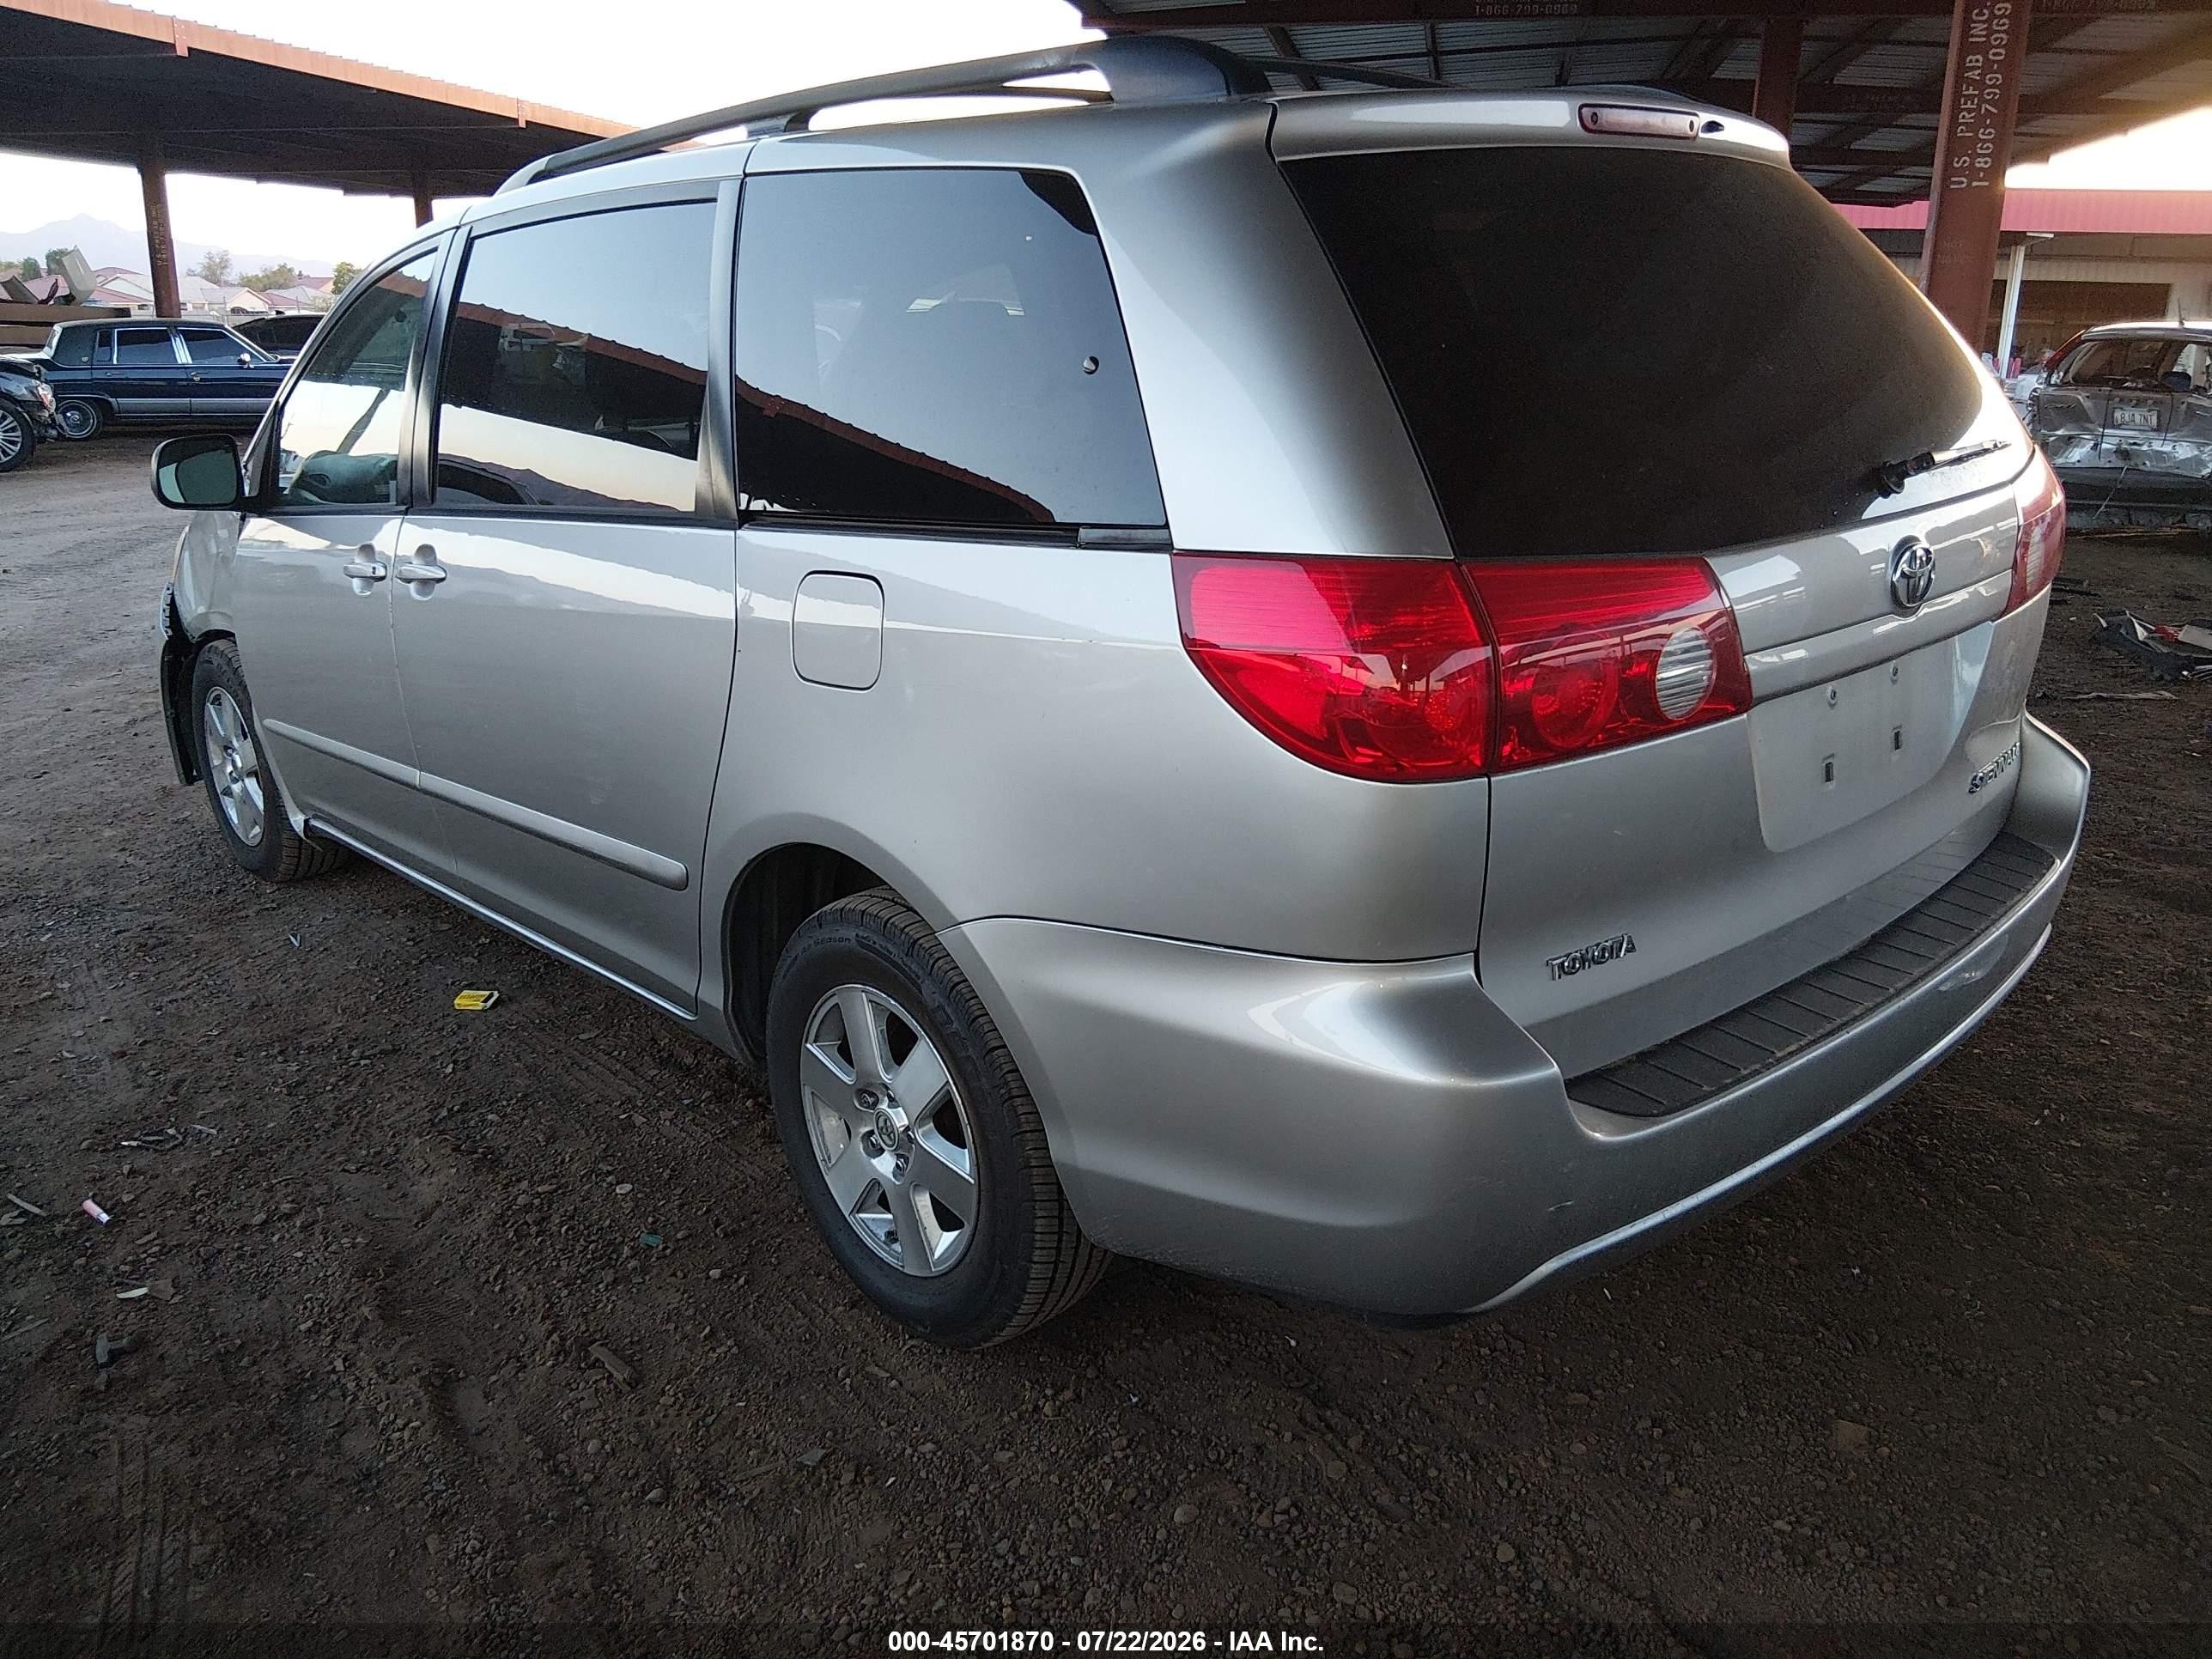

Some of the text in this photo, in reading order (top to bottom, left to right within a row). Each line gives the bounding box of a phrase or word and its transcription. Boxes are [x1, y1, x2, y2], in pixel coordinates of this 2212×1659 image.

[1950, 2, 1991, 188] U.S. PREFAB INC.
[1972, 3, 2012, 187] 1-866-799-0969
[1546, 933, 1637, 981] TOYOTA
